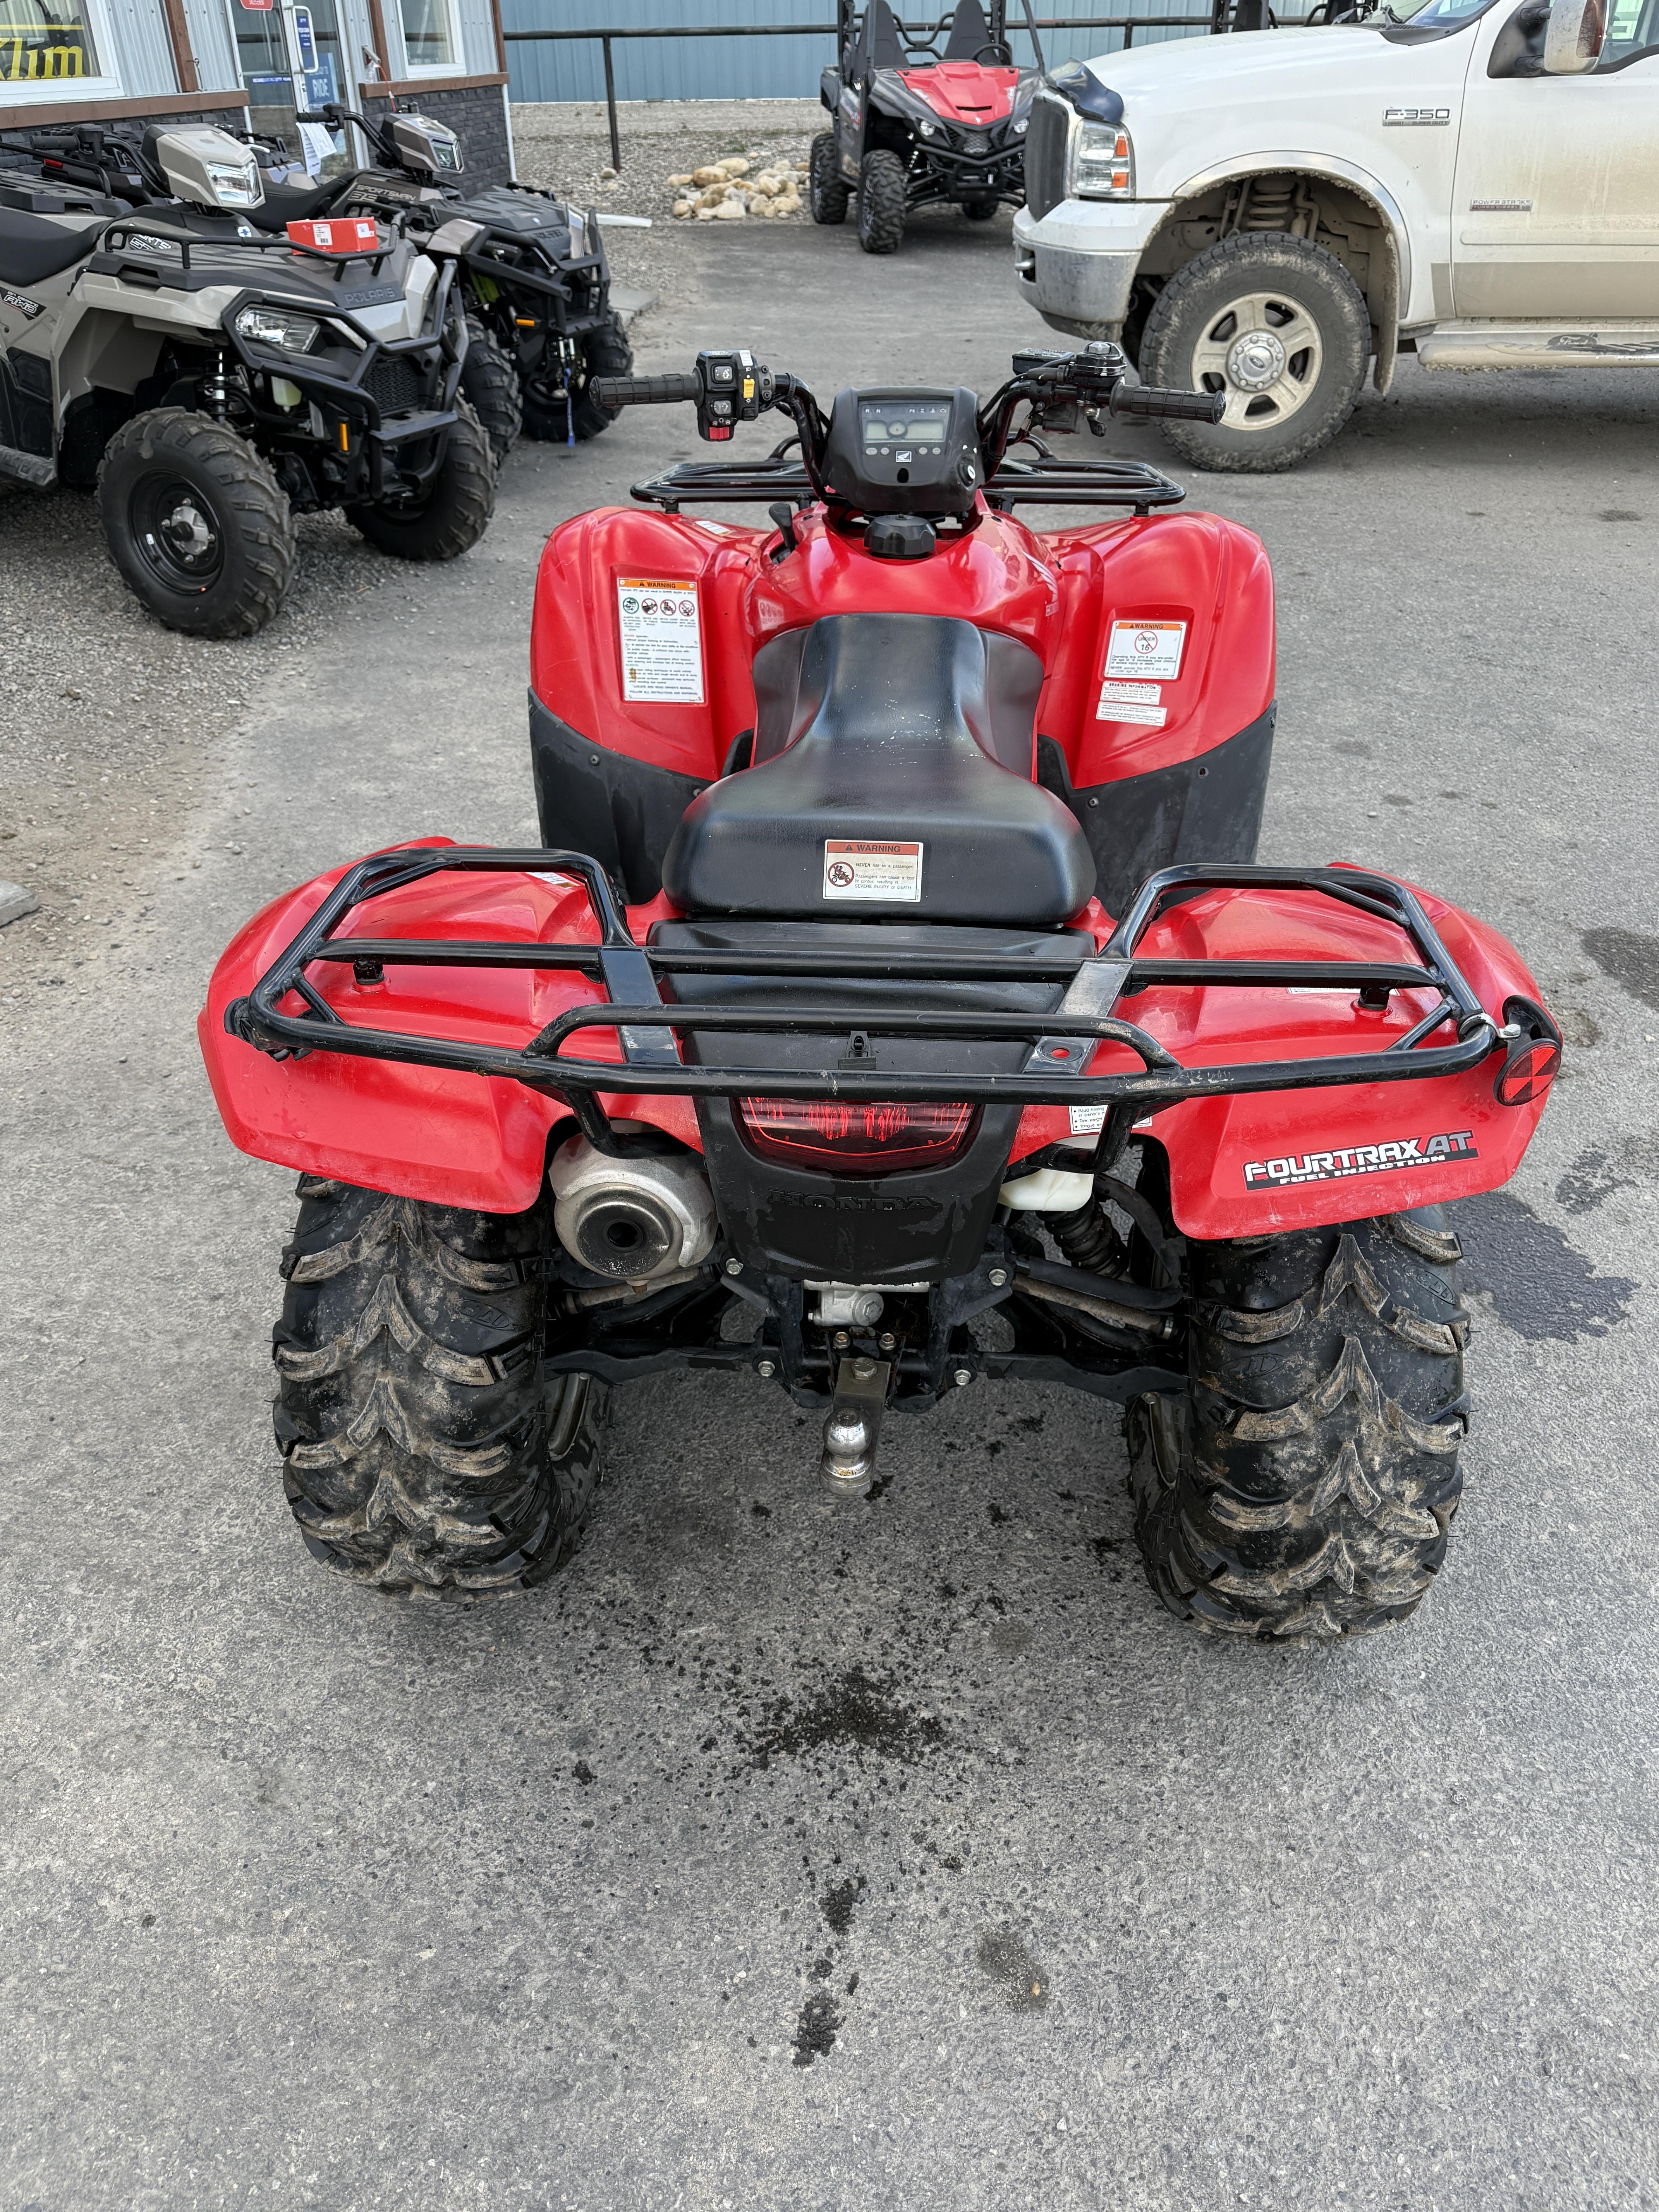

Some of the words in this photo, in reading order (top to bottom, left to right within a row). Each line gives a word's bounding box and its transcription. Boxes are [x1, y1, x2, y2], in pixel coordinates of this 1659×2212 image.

[1385, 109, 1449, 119] F-350
[355, 184, 416, 200] SPORTSMAN
[3, 294, 37, 313] AWD
[344, 287, 395, 304] POLARIS
[1245, 1138, 1419, 1182] FOURTRAX
[1426, 1132, 1472, 1155] AT
[1279, 1173, 1329, 1184] FUEL
[1334, 1155, 1446, 1176] INJECTION
[768, 1188, 938, 1212] HONDA
